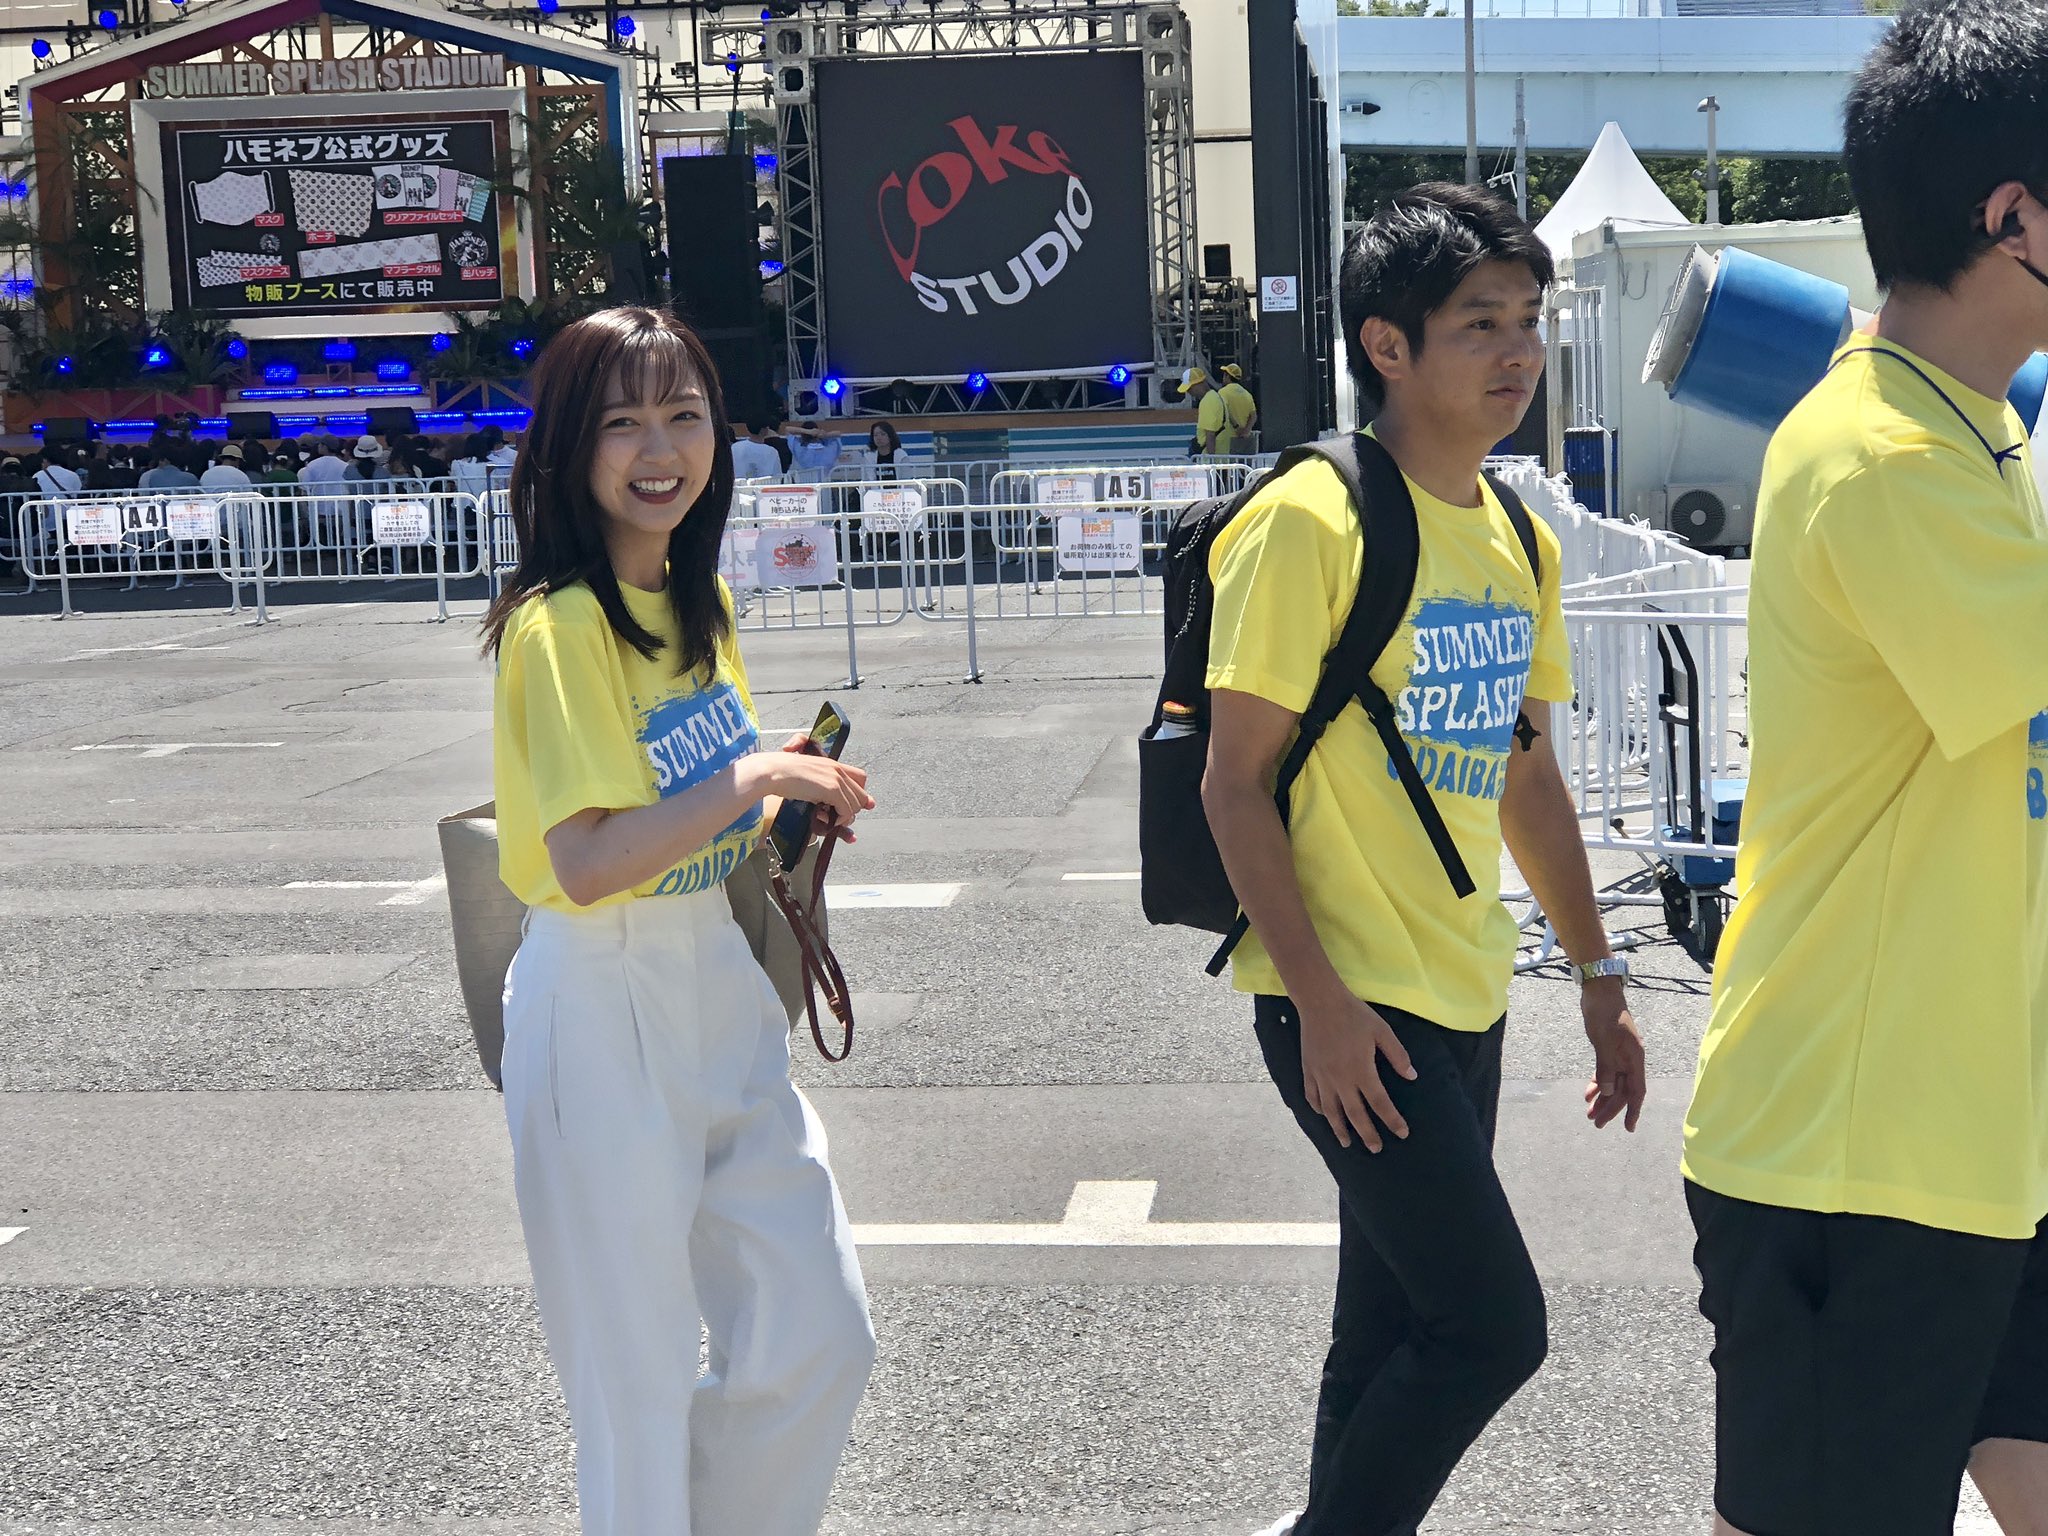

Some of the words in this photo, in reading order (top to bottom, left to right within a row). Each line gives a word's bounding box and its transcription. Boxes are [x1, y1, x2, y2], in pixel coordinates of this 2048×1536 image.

[149, 64, 266, 97] SUMMER
[272, 59, 376, 93] SPLASH
[381, 53, 505, 91] STADIUM
[223, 132, 450, 164] ハモネプ公式グッズ
[256, 216, 281, 224] マスク
[384, 211, 461, 222] クリアファイルセット
[910, 175, 1093, 315] STUDIO
[241, 267, 289, 277] マスクケース
[385, 266, 440, 275] マフラータオル
[245, 279, 434, 302] 物販ブースにて販売中
[771, 506, 806, 514] 持ち込みは
